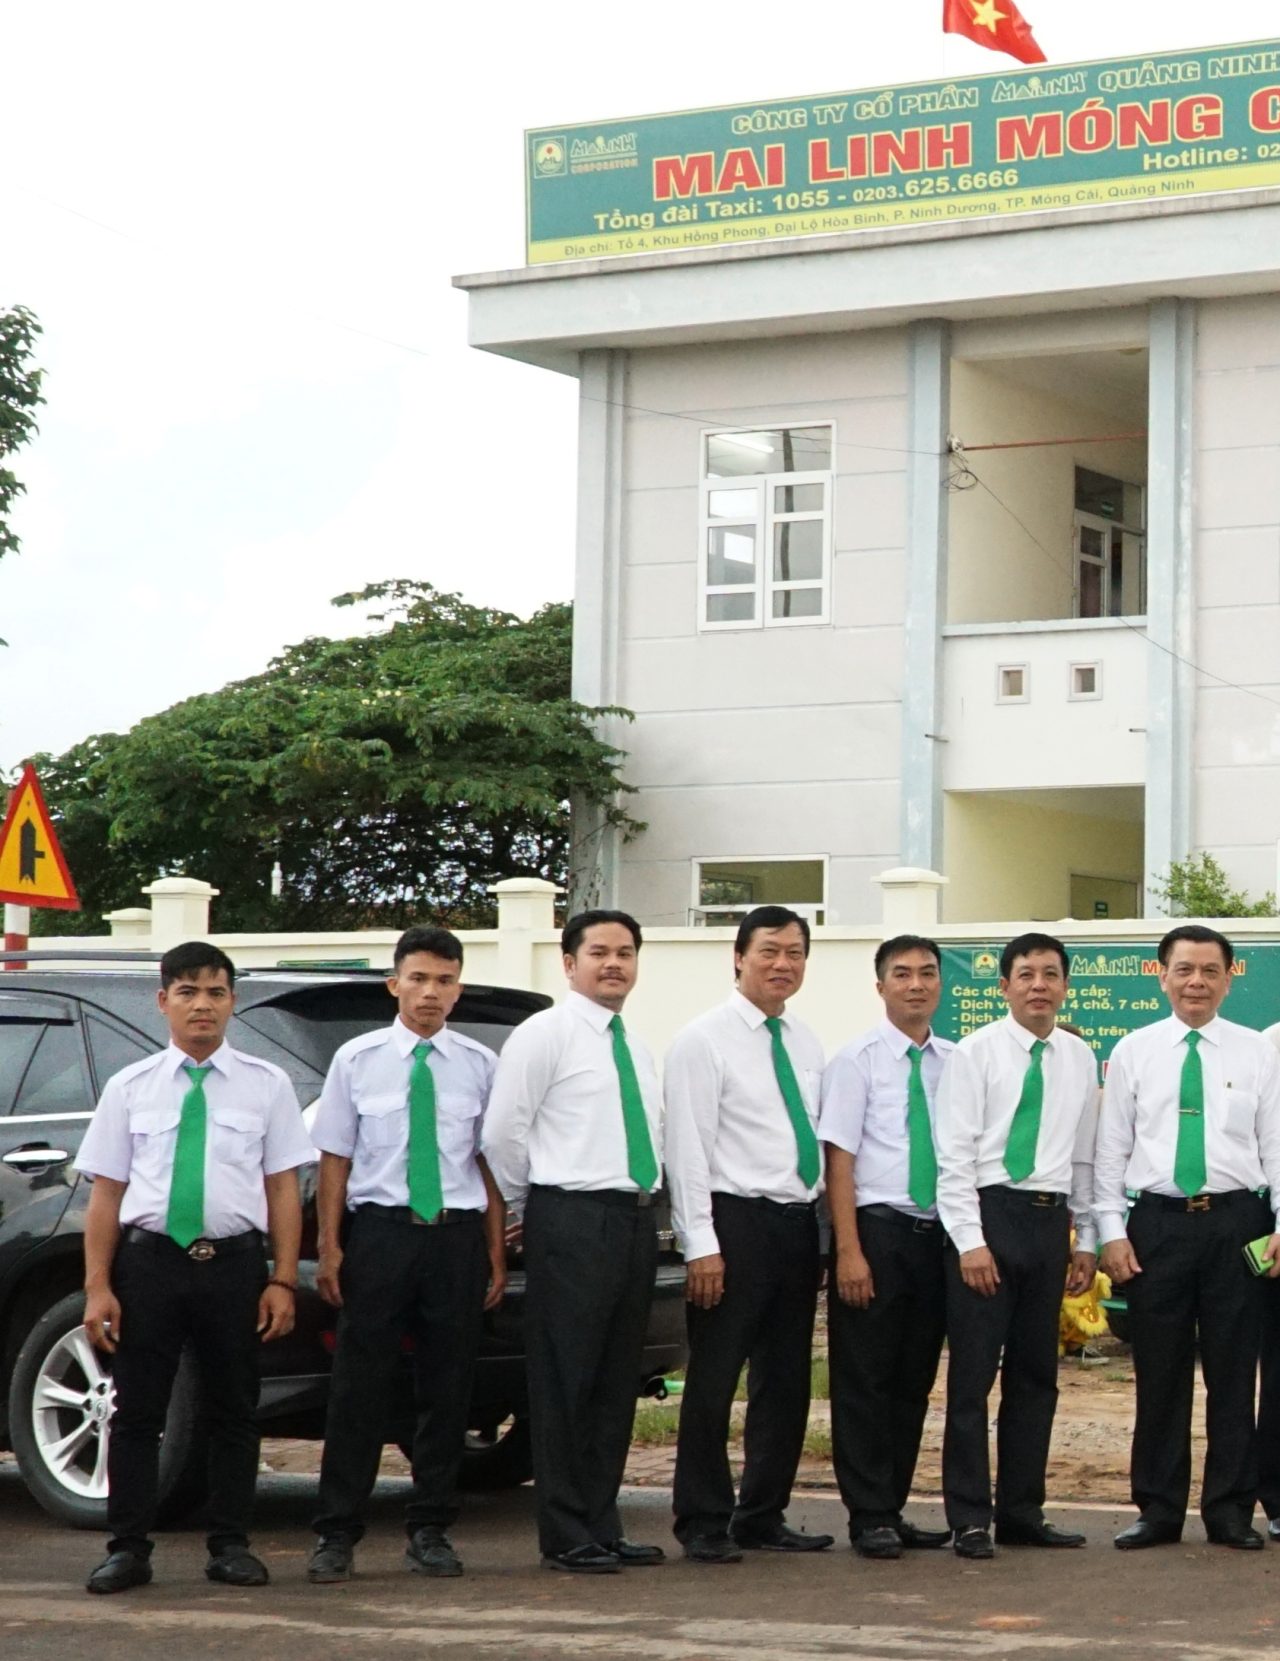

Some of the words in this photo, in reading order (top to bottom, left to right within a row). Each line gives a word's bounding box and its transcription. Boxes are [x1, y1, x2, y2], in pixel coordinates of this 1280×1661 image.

[732, 108, 808, 134] CÔNG
[813, 102, 848, 125] TY
[854, 91, 894, 120] CỔ
[899, 84, 979, 115] PHẦN
[1098, 61, 1200, 92] QUẢNG
[653, 143, 785, 201] MAI
[809, 122, 972, 184] LINH
[997, 93, 1223, 163] MÓNG
[1143, 147, 1248, 171] Hotline:
[564, 245, 586, 257] Địa
[653, 234, 679, 247] Khu
[723, 226, 770, 240] Phong,
[775, 222, 797, 234] Đại
[801, 219, 818, 231] Lộ
[823, 216, 849, 228] Hòa
[894, 210, 903, 220] P.
[910, 206, 942, 218] Ninh
[947, 202, 1001, 215] Dương,
[1005, 197, 1026, 208] TP.
[1031, 193, 1071, 206] Móng
[1161, 179, 1195, 191] Ninh
[594, 207, 655, 230] Tổng
[662, 204, 698, 222] đài
[705, 197, 763, 218] Taxi:
[773, 189, 829, 211] 1055
[853, 168, 1019, 202] 0203.625.6666
[952, 985, 979, 997] Các
[983, 986, 1006, 999] dịc
[960, 999, 993, 1012] Dịch
[1070, 1000, 1079, 1010] 4
[1119, 1000, 1128, 1010] 7
[960, 1012, 993, 1024] Dịch
